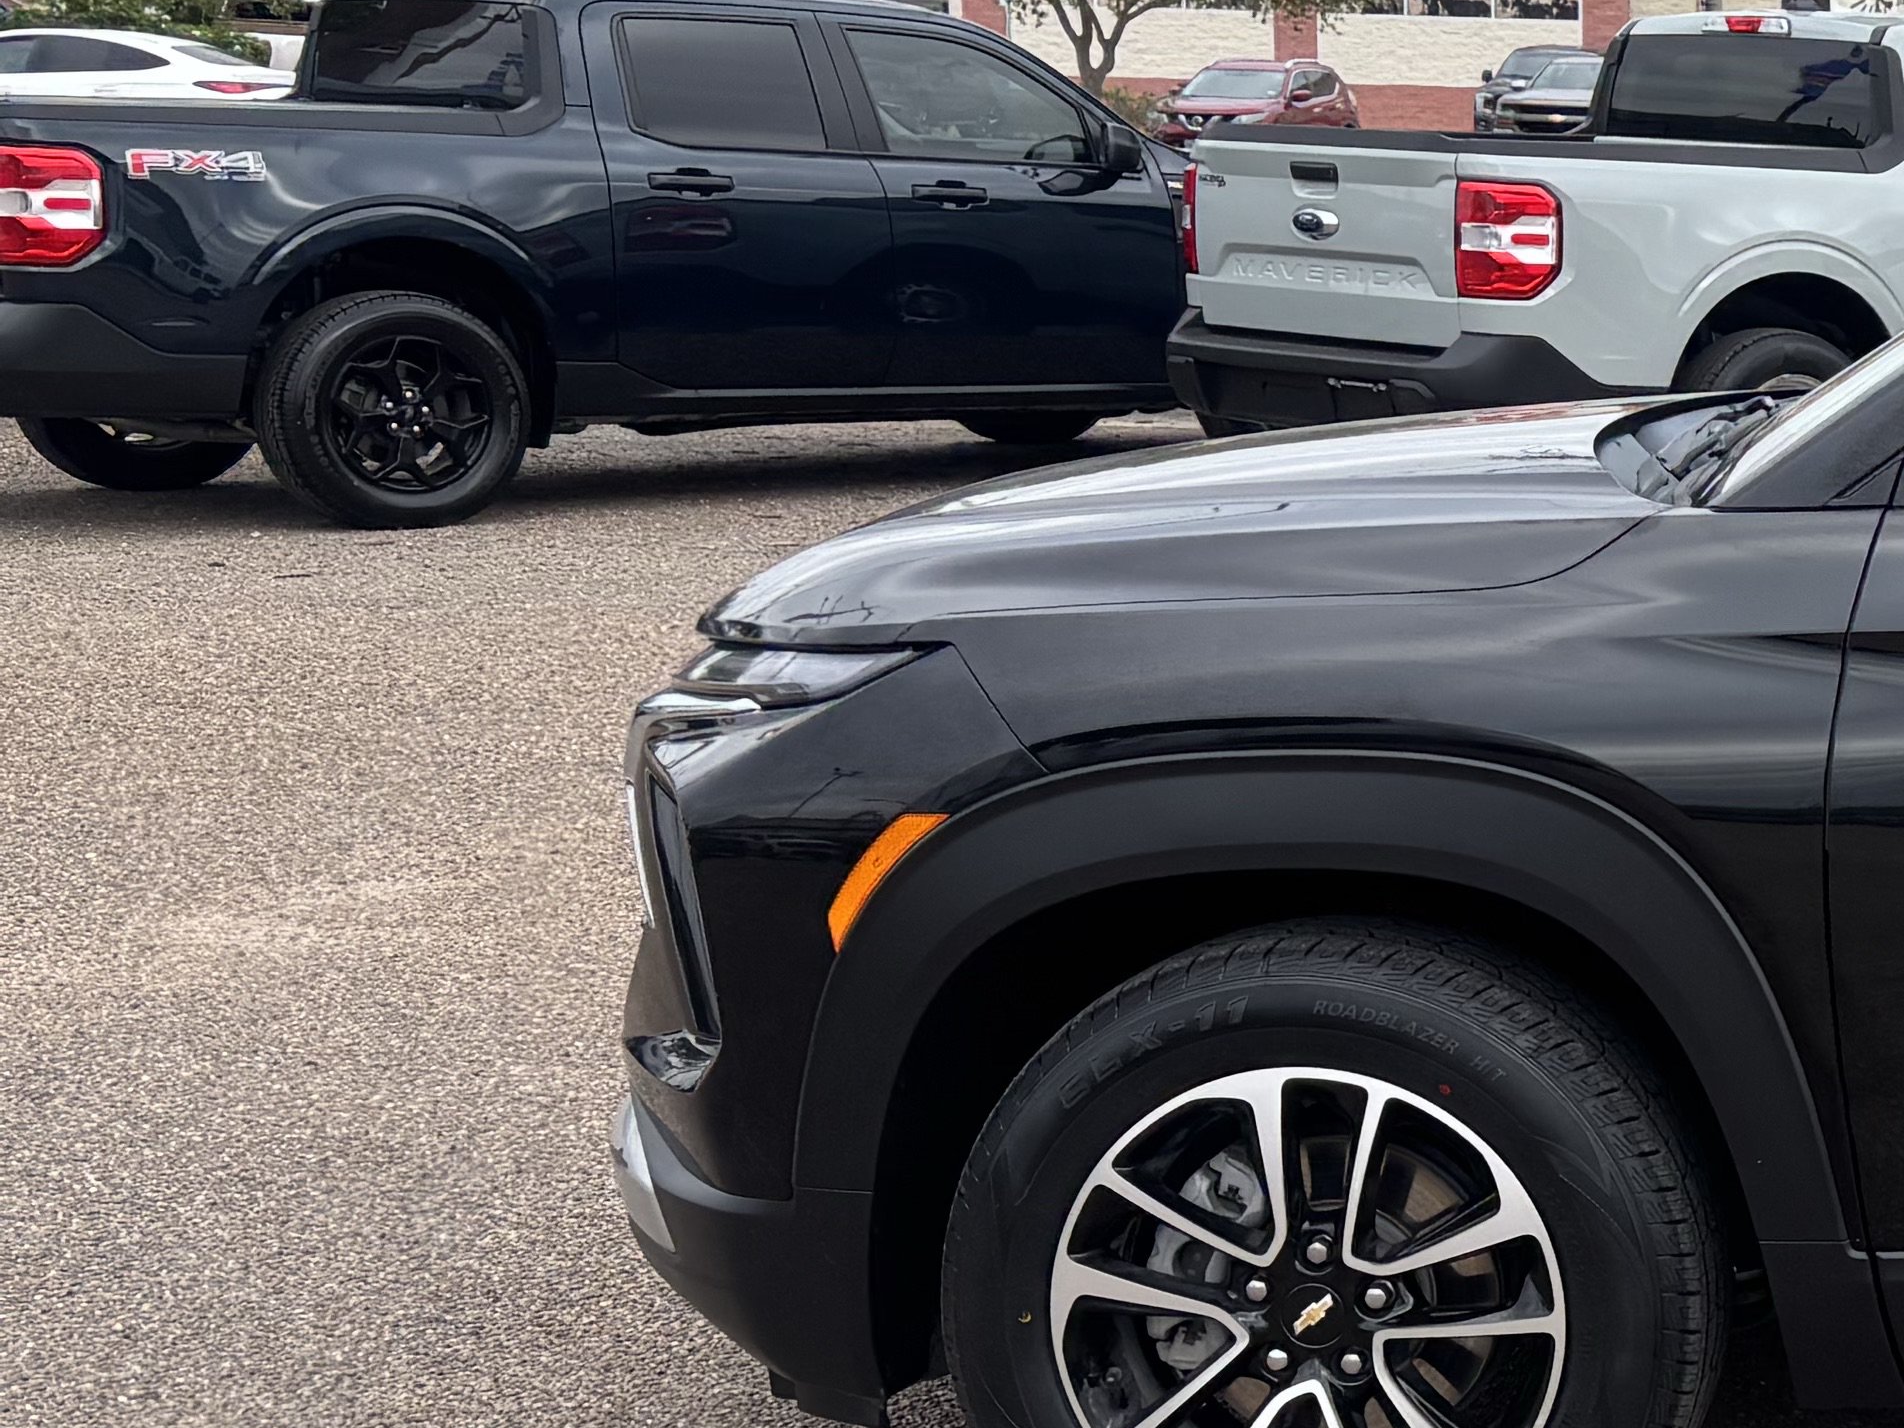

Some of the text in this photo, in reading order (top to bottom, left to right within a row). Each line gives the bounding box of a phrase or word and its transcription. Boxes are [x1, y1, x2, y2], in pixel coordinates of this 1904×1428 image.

[125, 148, 267, 180] FX4
[1232, 256, 1418, 290] MAVERICK
[1312, 1000, 1462, 1055] ROADBLAZER
